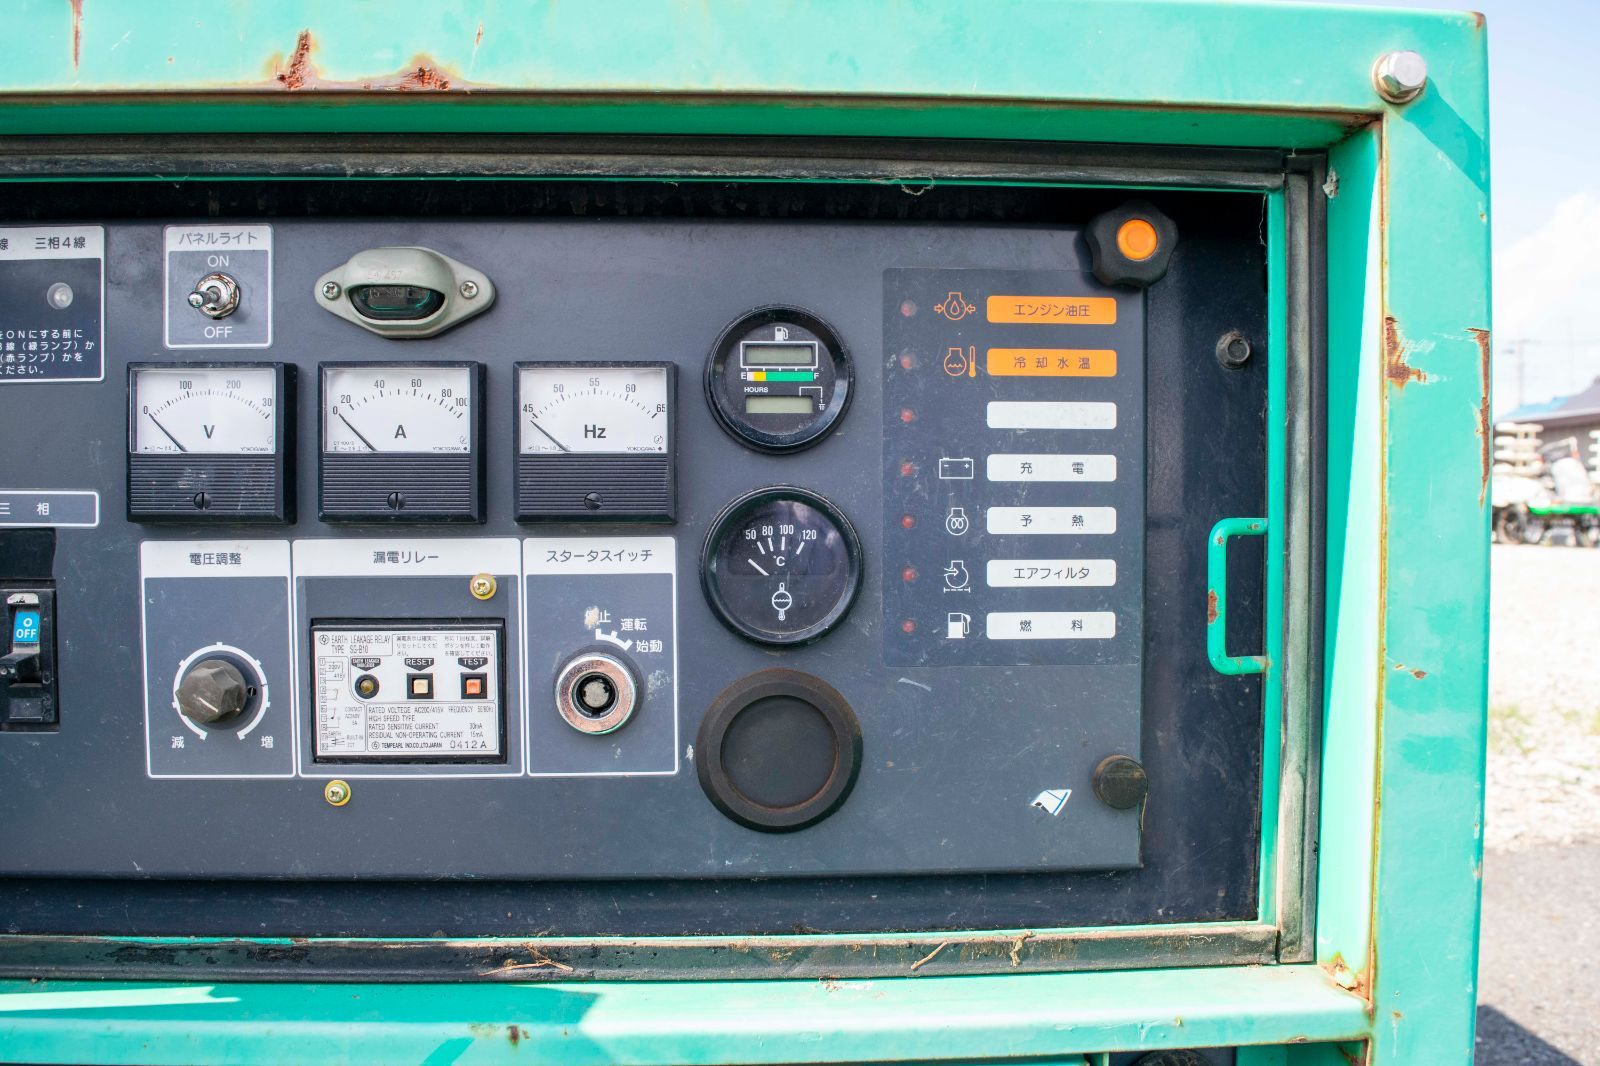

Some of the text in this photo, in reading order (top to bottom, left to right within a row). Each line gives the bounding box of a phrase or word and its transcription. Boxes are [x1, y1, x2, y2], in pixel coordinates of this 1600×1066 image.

[179, 231, 258, 246] パネルライト
[207, 255, 230, 268] ON
[1013, 303, 1091, 318] エンジン油圧
[204, 326, 233, 339] OFF
[740, 372, 747, 380] E
[813, 372, 820, 380] F
[179, 380, 193, 390] 100
[226, 379, 241, 389] 200
[374, 379, 385, 389] 40
[411, 378, 422, 388] 60
[589, 377, 600, 387] 55
[441, 388, 452, 398] 80
[553, 384, 564, 393] 50
[625, 384, 636, 393] 60
[340, 394, 351, 404] 20
[522, 403, 534, 413] 45
[656, 403, 666, 413] 65
[203, 424, 215, 440] V
[394, 424, 407, 439] A
[584, 424, 607, 439] Hz
[745, 530, 757, 540] 50
[762, 525, 774, 536] 80
[779, 524, 794, 535] 100
[802, 529, 817, 540] 120
[189, 552, 242, 565] 電圧調整
[373, 551, 439, 564] 漏電リレー
[546, 549, 653, 563] スタータスイッチ
[1013, 567, 1090, 580] エアフィルタ
[620, 618, 647, 631] 運転
[16, 628, 37, 639] OFF
[636, 640, 662, 653] 始動
[405, 658, 432, 666] RESET
[463, 657, 485, 665] TEST
[171, 736, 185, 749] 減
[260, 736, 275, 749] 増
